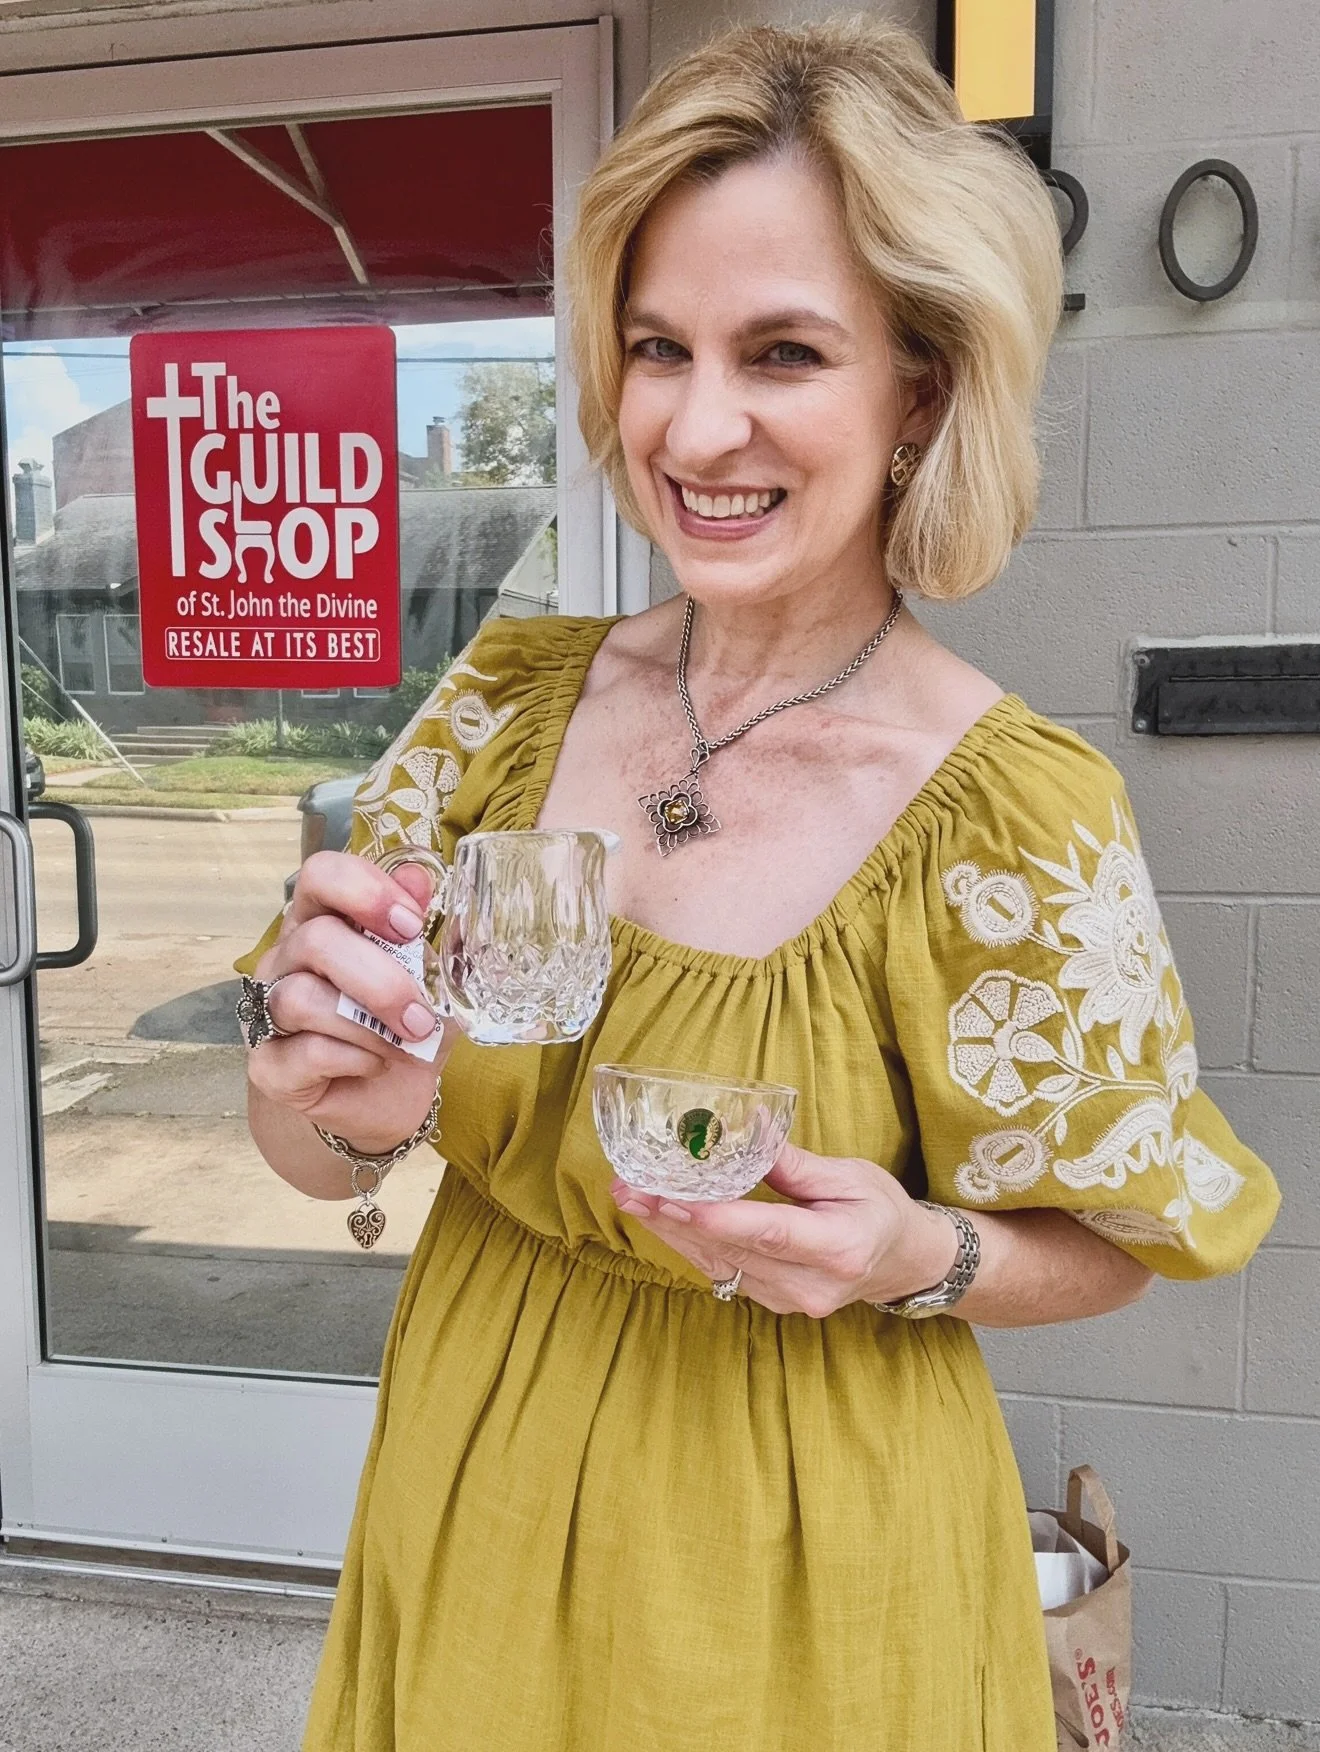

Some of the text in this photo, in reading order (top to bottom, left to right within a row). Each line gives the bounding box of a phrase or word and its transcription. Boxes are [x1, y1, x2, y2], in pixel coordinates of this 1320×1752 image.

[191, 362, 280, 430] The
[190, 432, 383, 504] GUILD
[198, 506, 379, 583] SHOP
[176, 590, 378, 619] of St. John the Divine
[168, 630, 377, 658] RESALE AT ITS BEST
[368, 934, 412, 965] WATERFORD
